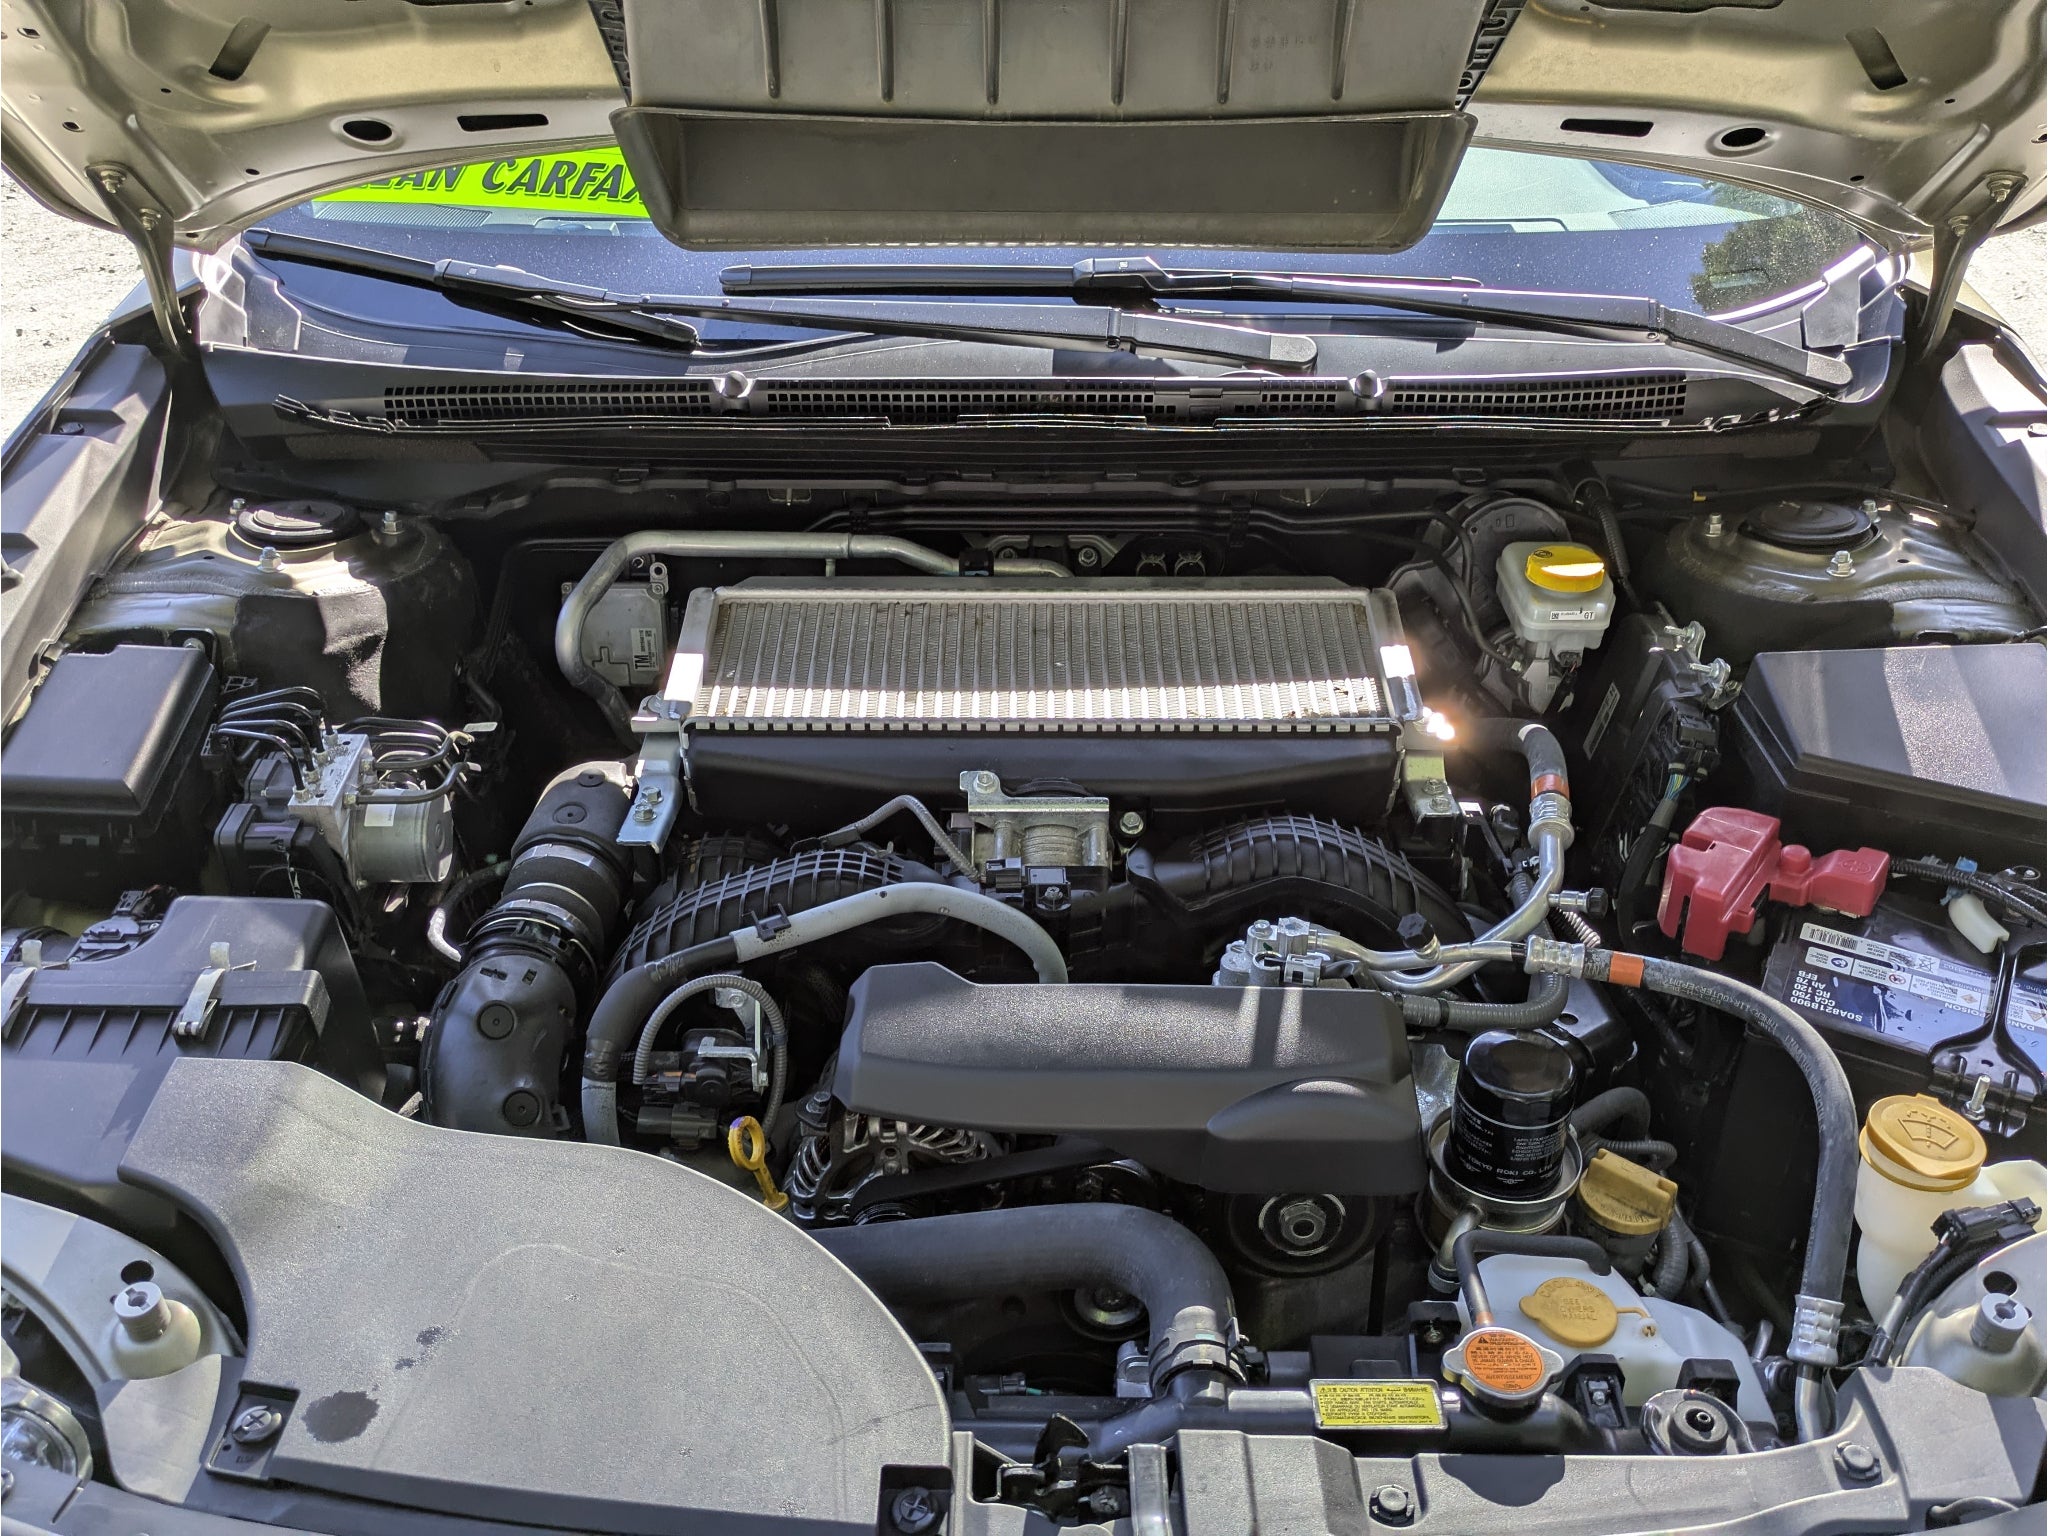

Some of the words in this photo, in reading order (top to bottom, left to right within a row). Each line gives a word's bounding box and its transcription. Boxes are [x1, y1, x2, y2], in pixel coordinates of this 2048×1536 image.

[634, 654, 650, 670] TM
[1795, 976, 1809, 986] 76
[1798, 970, 1818, 981] EFB
[1794, 983, 1813, 994] 120
[1811, 981, 1826, 990] Ah
[1792, 989, 1811, 1000] 750
[1815, 990, 1831, 999] RC
[1814, 995, 1836, 1007] CCA
[1467, 1155, 1493, 1171] TOKYO
[1496, 1168, 1519, 1176] ROKI
[1539, 1279, 1605, 1298] COOLANT
